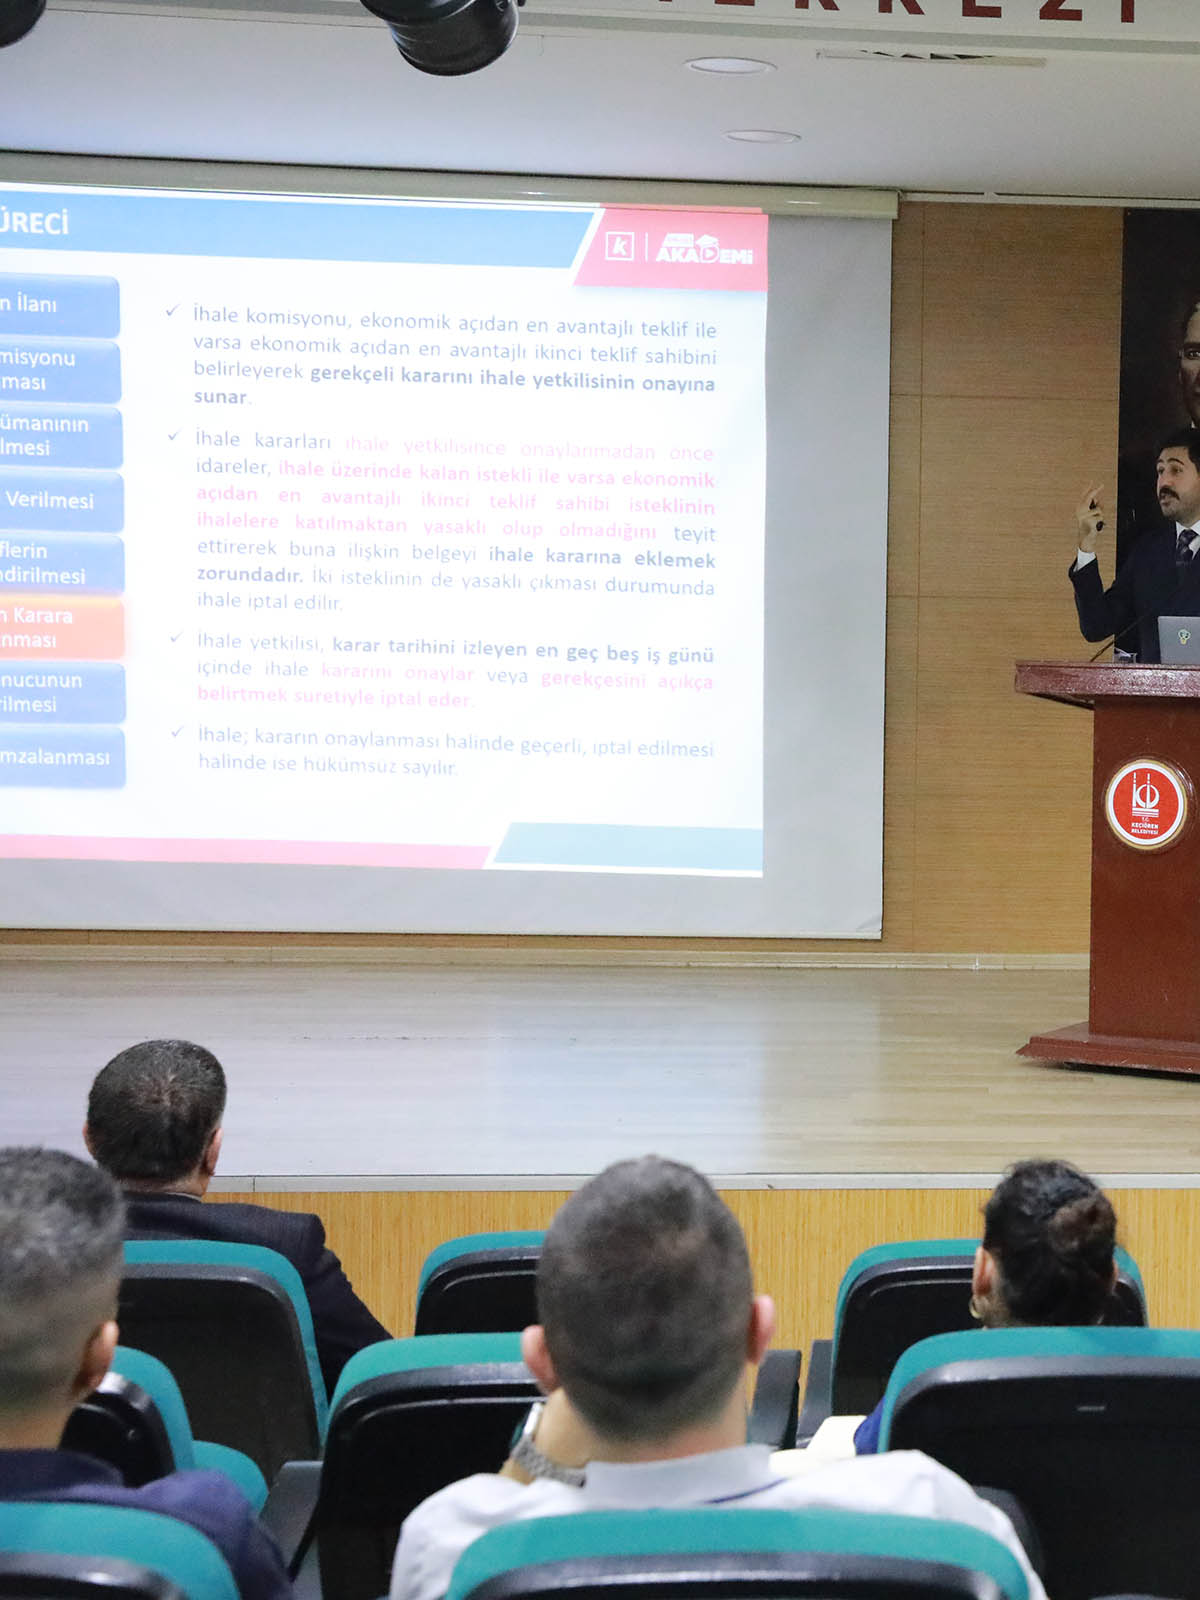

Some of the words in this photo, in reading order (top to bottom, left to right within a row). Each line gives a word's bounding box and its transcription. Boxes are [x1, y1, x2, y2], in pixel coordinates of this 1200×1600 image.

[0, 205, 69, 235] ÜRECİ
[17, 291, 57, 313] İlanı
[193, 301, 238, 324] İhale
[247, 306, 352, 331] komisyonu,
[360, 310, 450, 330] ekonomik
[459, 313, 518, 336] açıdan
[527, 320, 548, 333] en
[556, 317, 633, 340] avantajlı
[641, 318, 689, 337] teklif
[696, 319, 717, 338] ile
[193, 337, 241, 351] varsa
[250, 334, 342, 354] ekonomik
[350, 337, 409, 360] açıdan
[419, 344, 440, 357] en
[449, 340, 526, 363] avantajlı
[535, 341, 582, 361] ikinci
[591, 343, 638, 362] teklif
[645, 345, 716, 364] sahibini
[193, 358, 304, 383] belirleyerek
[311, 362, 394, 386] gerekçeli
[401, 364, 473, 384] kararını
[480, 367, 526, 386] ihale
[533, 369, 635, 391] yetkilisinin
[642, 377, 716, 395] onayına
[0, 413, 89, 433] ümanının
[255, 430, 331, 450] kararları
[196, 456, 272, 480] idareler,
[279, 458, 324, 477] ihale
[331, 461, 412, 480] üzerinde
[419, 462, 470, 481] kalan
[477, 464, 531, 483] istekli
[538, 465, 560, 484] ile
[567, 471, 615, 485] varsa
[622, 467, 714, 488] ekonomik
[6, 490, 94, 510] Verilmesi
[196, 483, 257, 506] açıdan
[279, 490, 301, 504] en
[321, 487, 401, 510] avantajlı
[489, 491, 536, 510] teklif
[555, 493, 609, 512] sahibi
[629, 495, 716, 515] isteklinin
[197, 510, 279, 530] ihalelere
[295, 512, 407, 533] katılmaktan
[423, 517, 486, 539] yasaklı
[503, 518, 543, 542] olup
[559, 519, 656, 544] olmadığını
[674, 524, 716, 546] teyit
[197, 539, 277, 557] ettirerek
[289, 539, 336, 558] buna
[489, 544, 534, 563] ihale
[546, 545, 621, 566] kararına
[634, 548, 716, 568] eklemek
[0, 566, 86, 585] dirilmesi
[197, 565, 303, 585] zorundadır.
[431, 570, 452, 588] de
[462, 571, 521, 594] yasaklı
[529, 573, 596, 595] çıkması
[605, 574, 715, 595] durumunda
[197, 590, 241, 609] ihale
[14, 607, 73, 624] Karara
[332, 634, 381, 653] karar
[389, 636, 455, 655] tarihini
[464, 638, 527, 662] izleyen
[535, 645, 558, 658] en
[567, 646, 599, 664] geç
[607, 641, 639, 665] beş
[648, 644, 660, 666] iş
[668, 645, 714, 666] günü
[1, 674, 83, 689] nucunun
[197, 659, 252, 681] içinde
[265, 660, 309, 679] ihale
[404, 664, 474, 687] onaylar
[487, 670, 528, 689] veya
[541, 667, 647, 691] gerekçesini
[658, 670, 713, 693] açıkça
[197, 683, 287, 703] belirtmek
[380, 688, 421, 711] iptal
[0, 747, 110, 766] mzalanması
[324, 729, 439, 752] onaylanması
[446, 732, 514, 752] halinde
[638, 737, 714, 757] edilmesi
[199, 751, 266, 771] halinde
